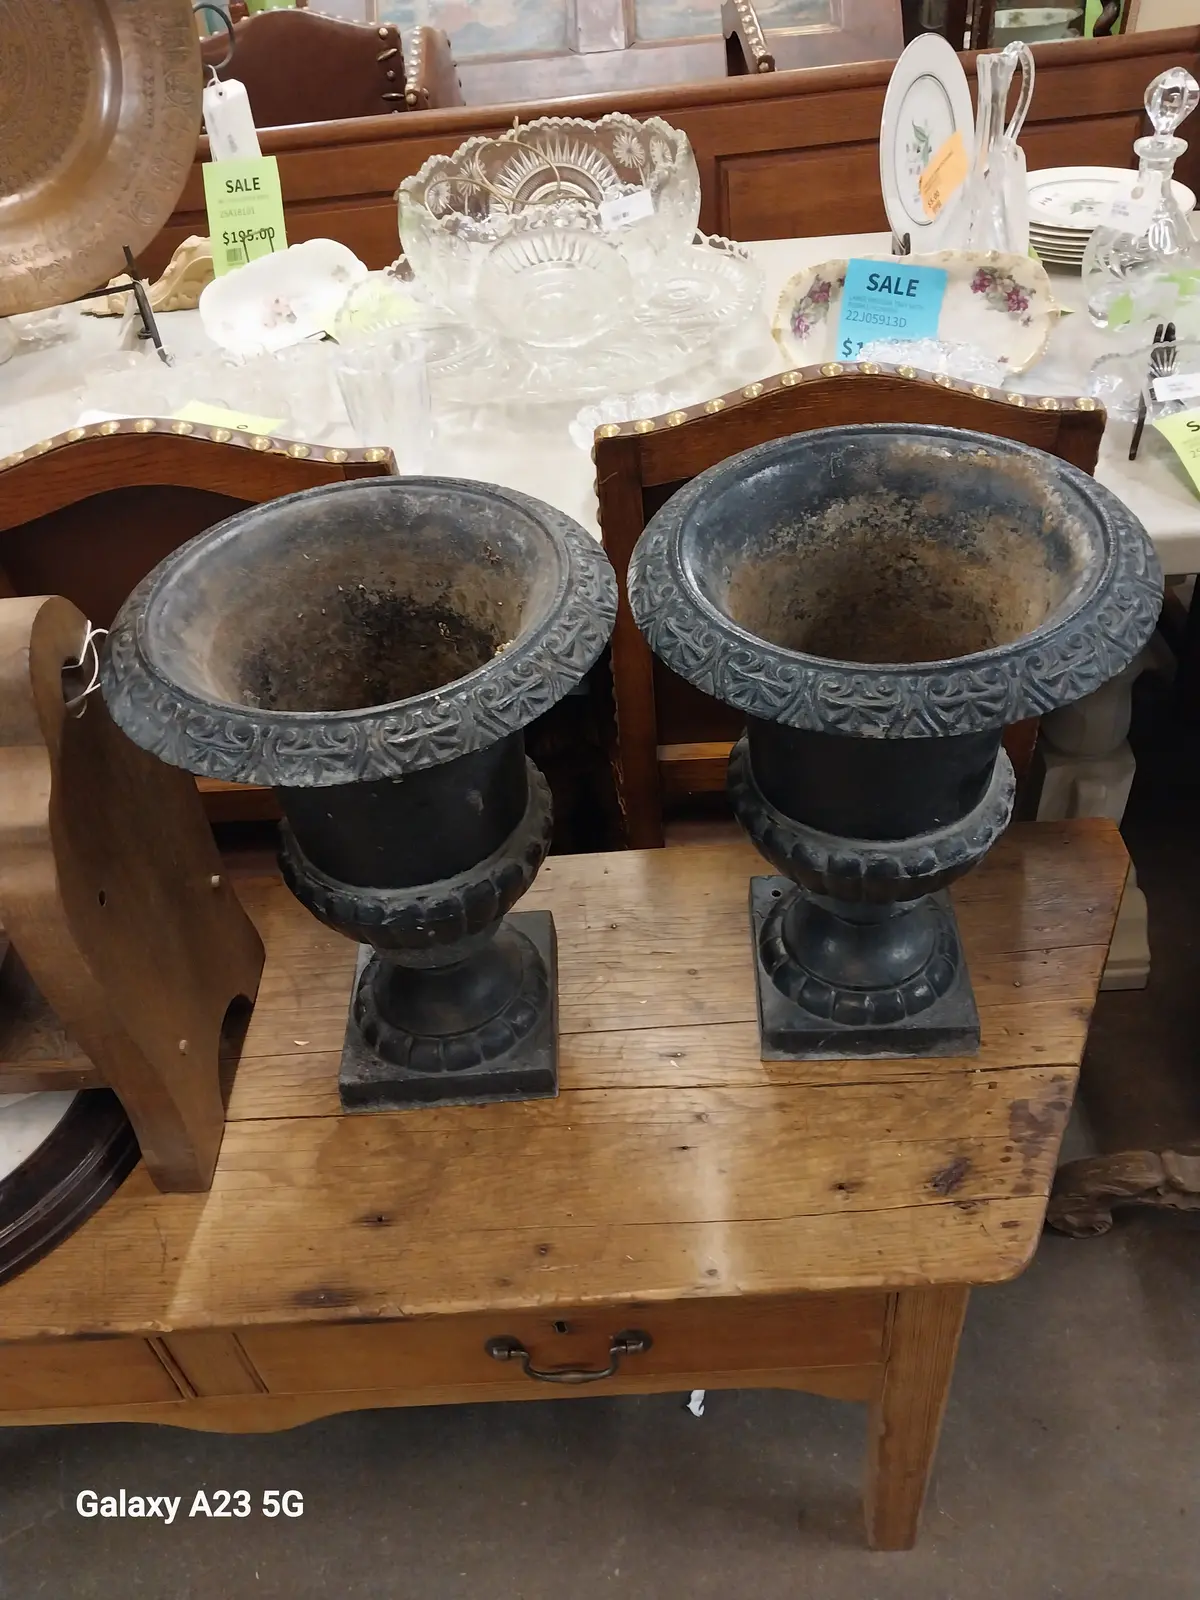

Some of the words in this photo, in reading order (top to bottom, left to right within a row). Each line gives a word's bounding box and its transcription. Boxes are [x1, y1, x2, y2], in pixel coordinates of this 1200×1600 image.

[225, 177, 261, 193] SALE
[222, 226, 276, 246] $195.00
[866, 273, 920, 297] SALE
[846, 310, 907, 328] 22J05913D
